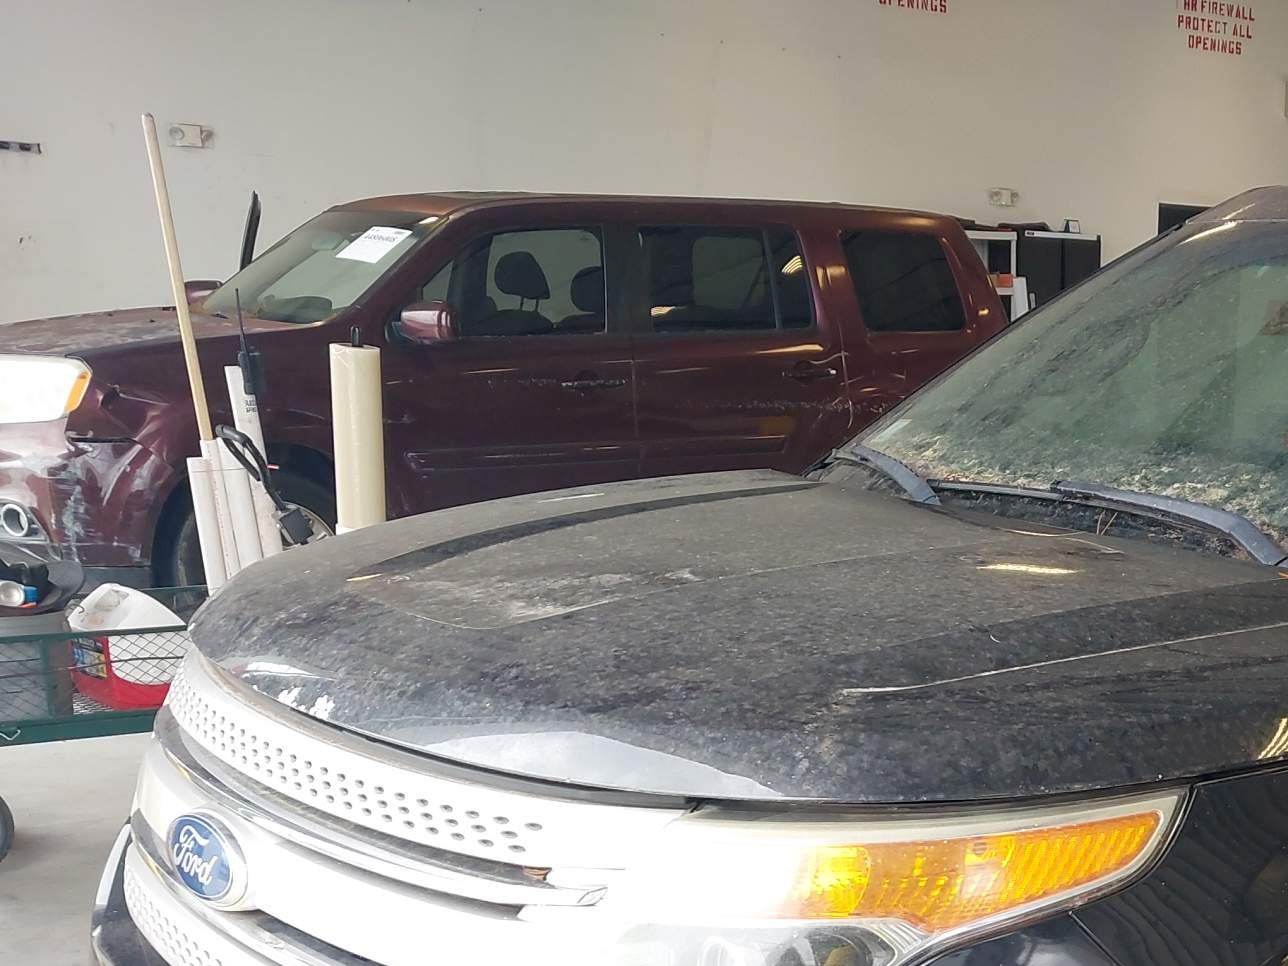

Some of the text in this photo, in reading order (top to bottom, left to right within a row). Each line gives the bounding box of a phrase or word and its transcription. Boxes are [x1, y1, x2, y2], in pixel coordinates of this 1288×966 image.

[1201, 0, 1255, 21] FIREWALL
[1177, 14, 1253, 40] PROTECT ALL
[1188, 34, 1242, 55] OPENINGS
[173, 825, 218, 886] Ford
